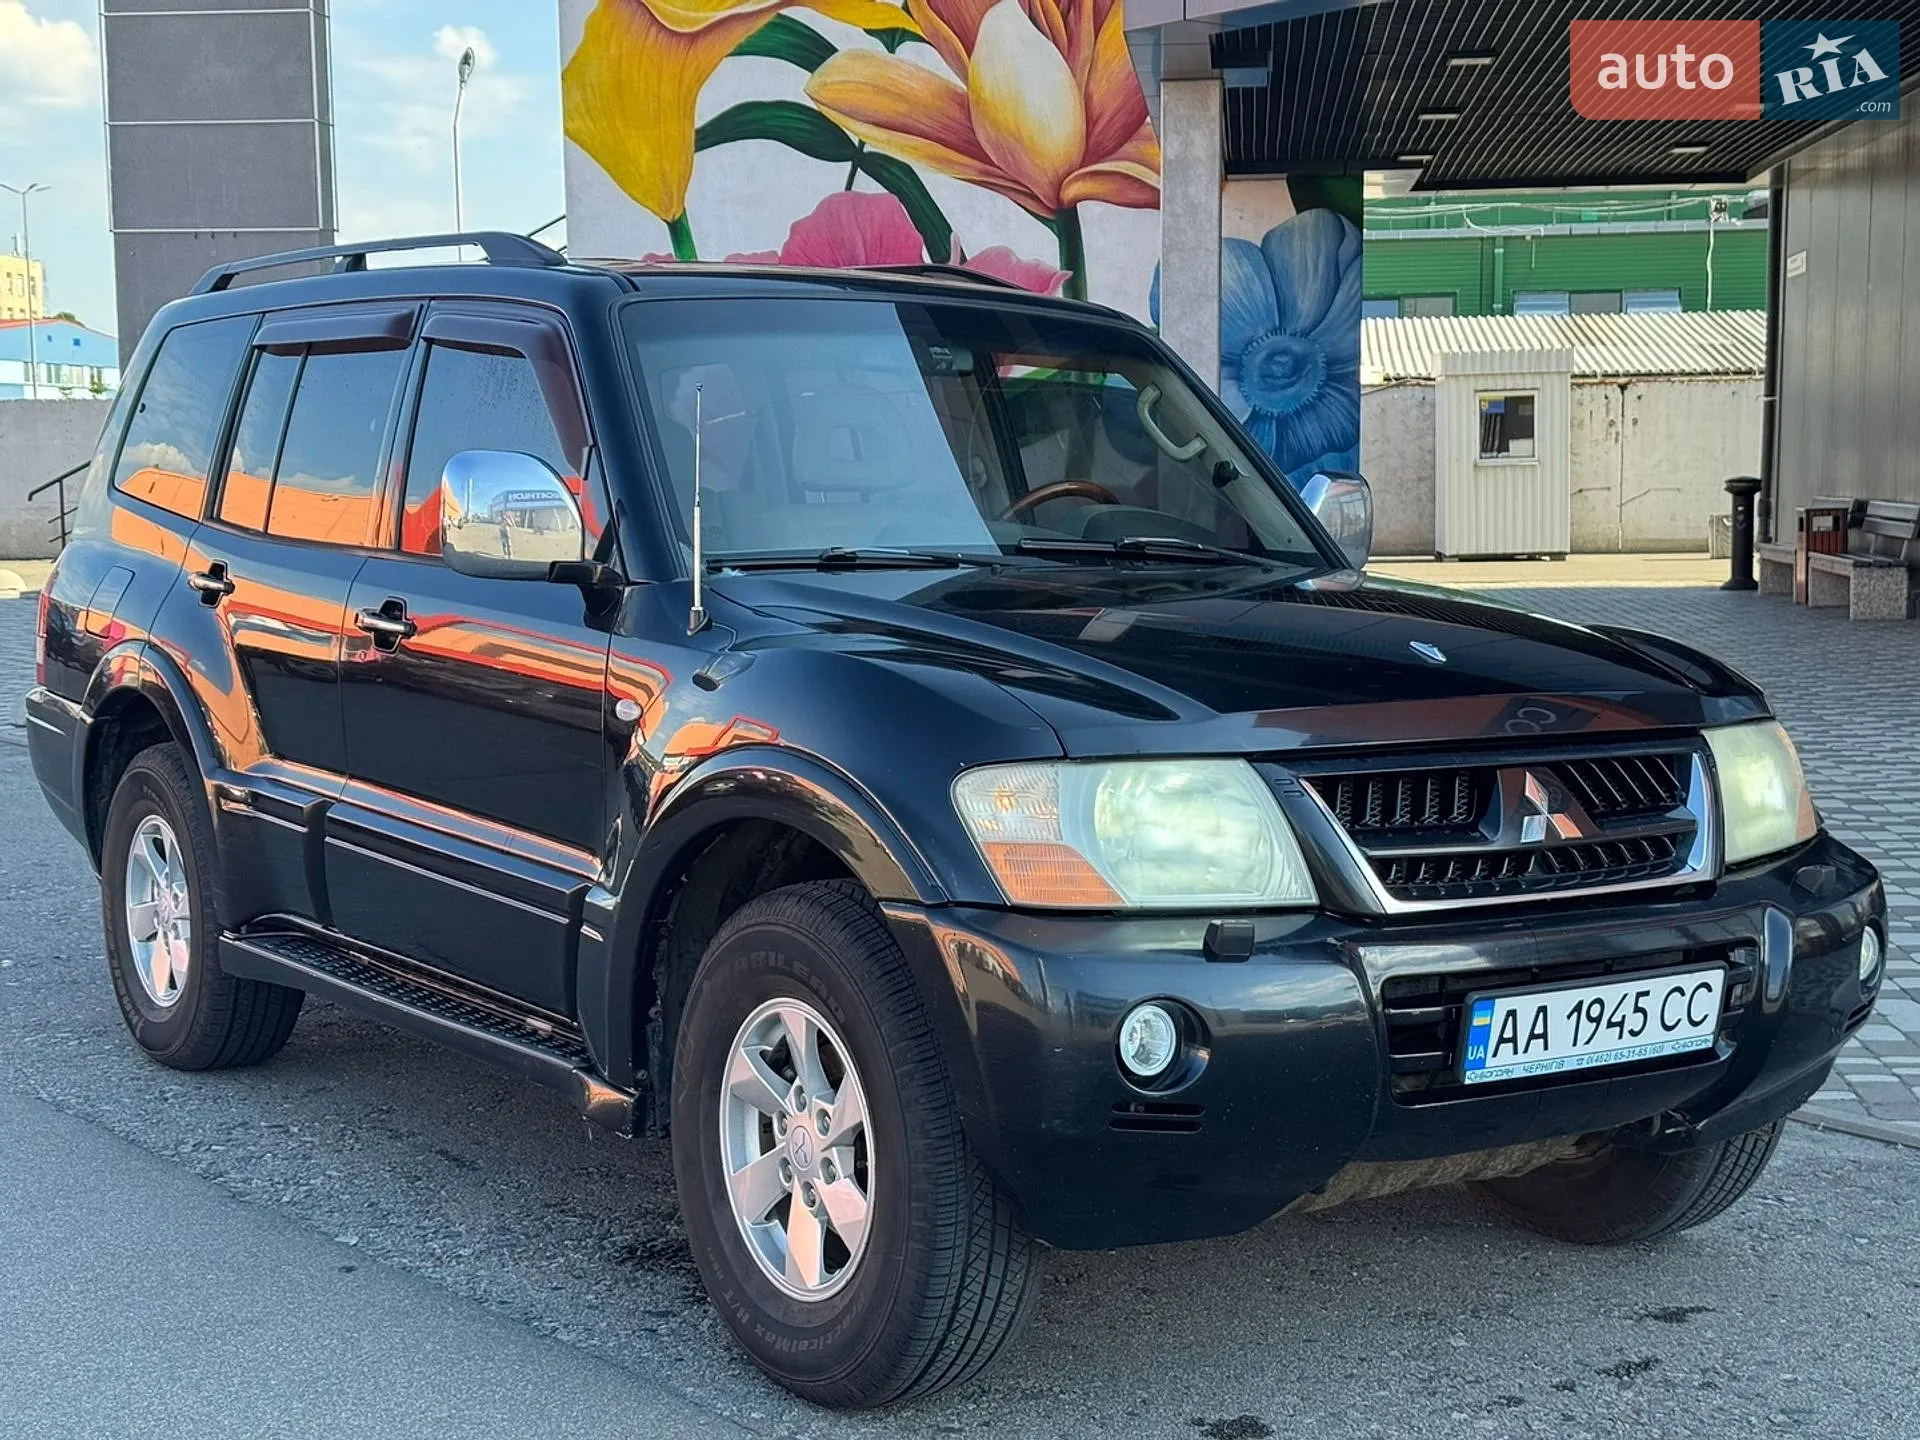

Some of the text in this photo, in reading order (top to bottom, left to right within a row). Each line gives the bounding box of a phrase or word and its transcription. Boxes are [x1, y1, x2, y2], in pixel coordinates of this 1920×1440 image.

[1491, 981, 1713, 1058] AA 1945 CC
[1467, 1045, 1485, 1061] UA
